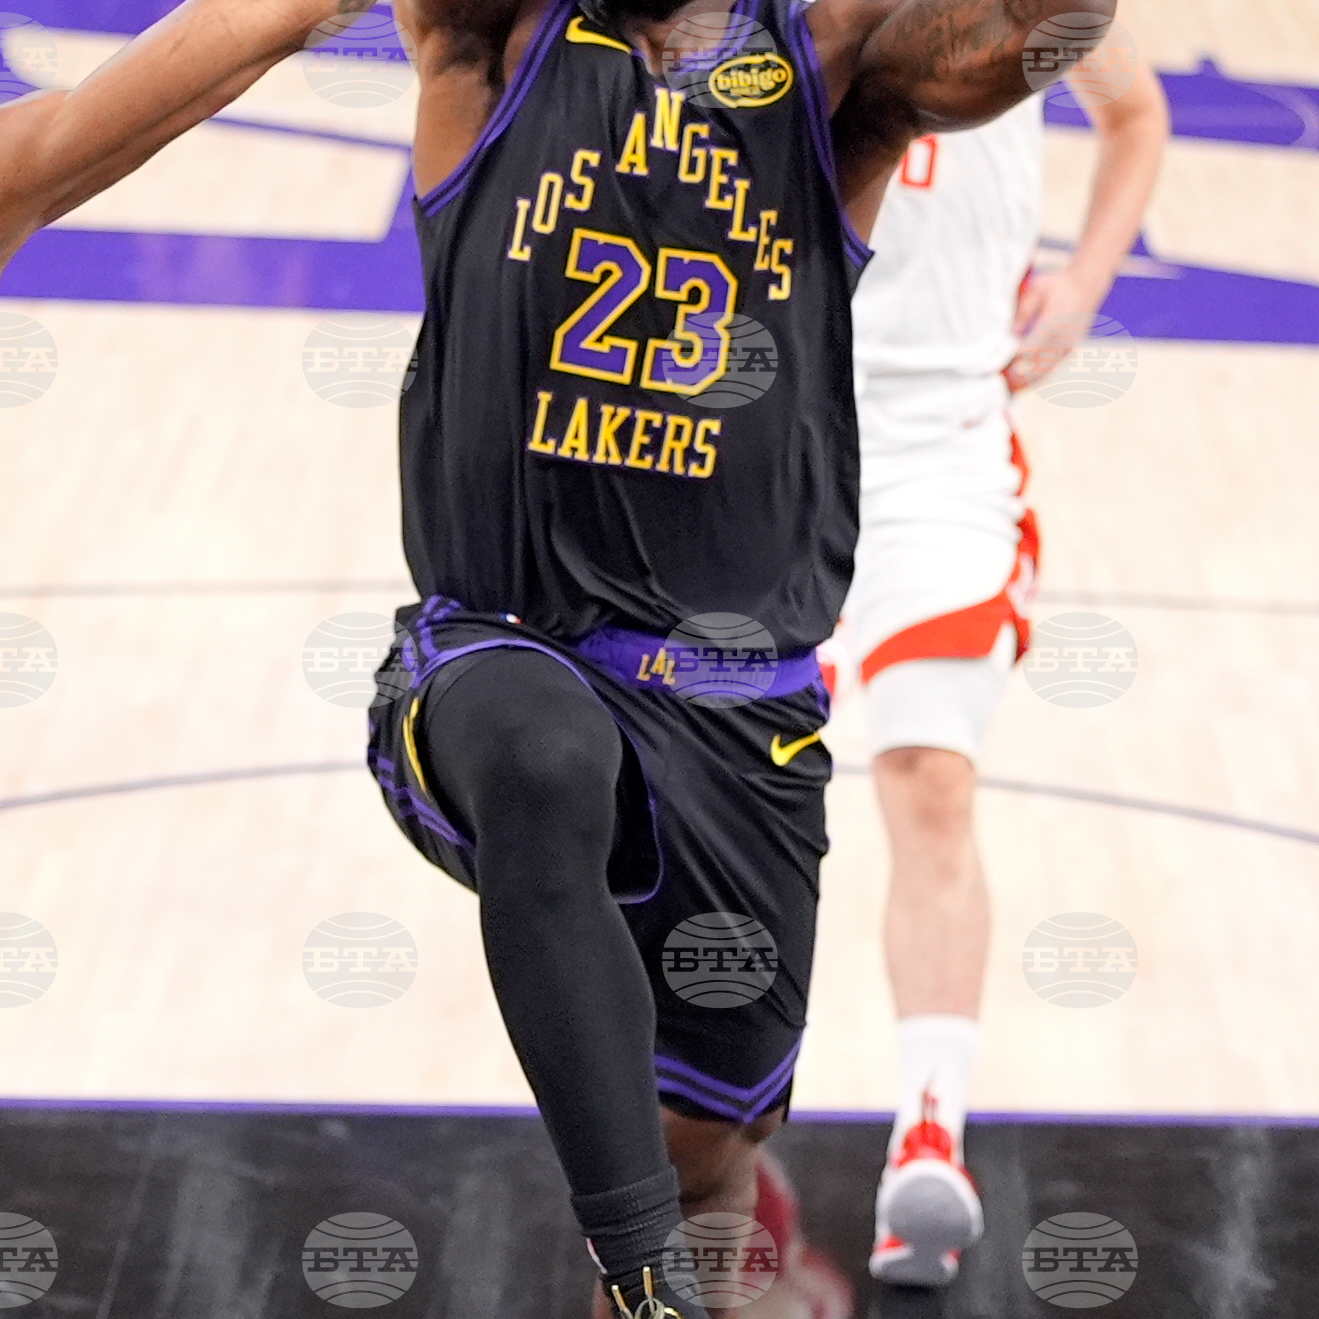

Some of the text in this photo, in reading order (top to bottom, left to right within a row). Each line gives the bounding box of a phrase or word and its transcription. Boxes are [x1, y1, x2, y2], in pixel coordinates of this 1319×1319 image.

[716, 66, 787, 92] bibigo
[508, 86, 794, 301] LOS ANGELES
[548, 227, 739, 397] 23
[528, 390, 723, 479] LAKERS
